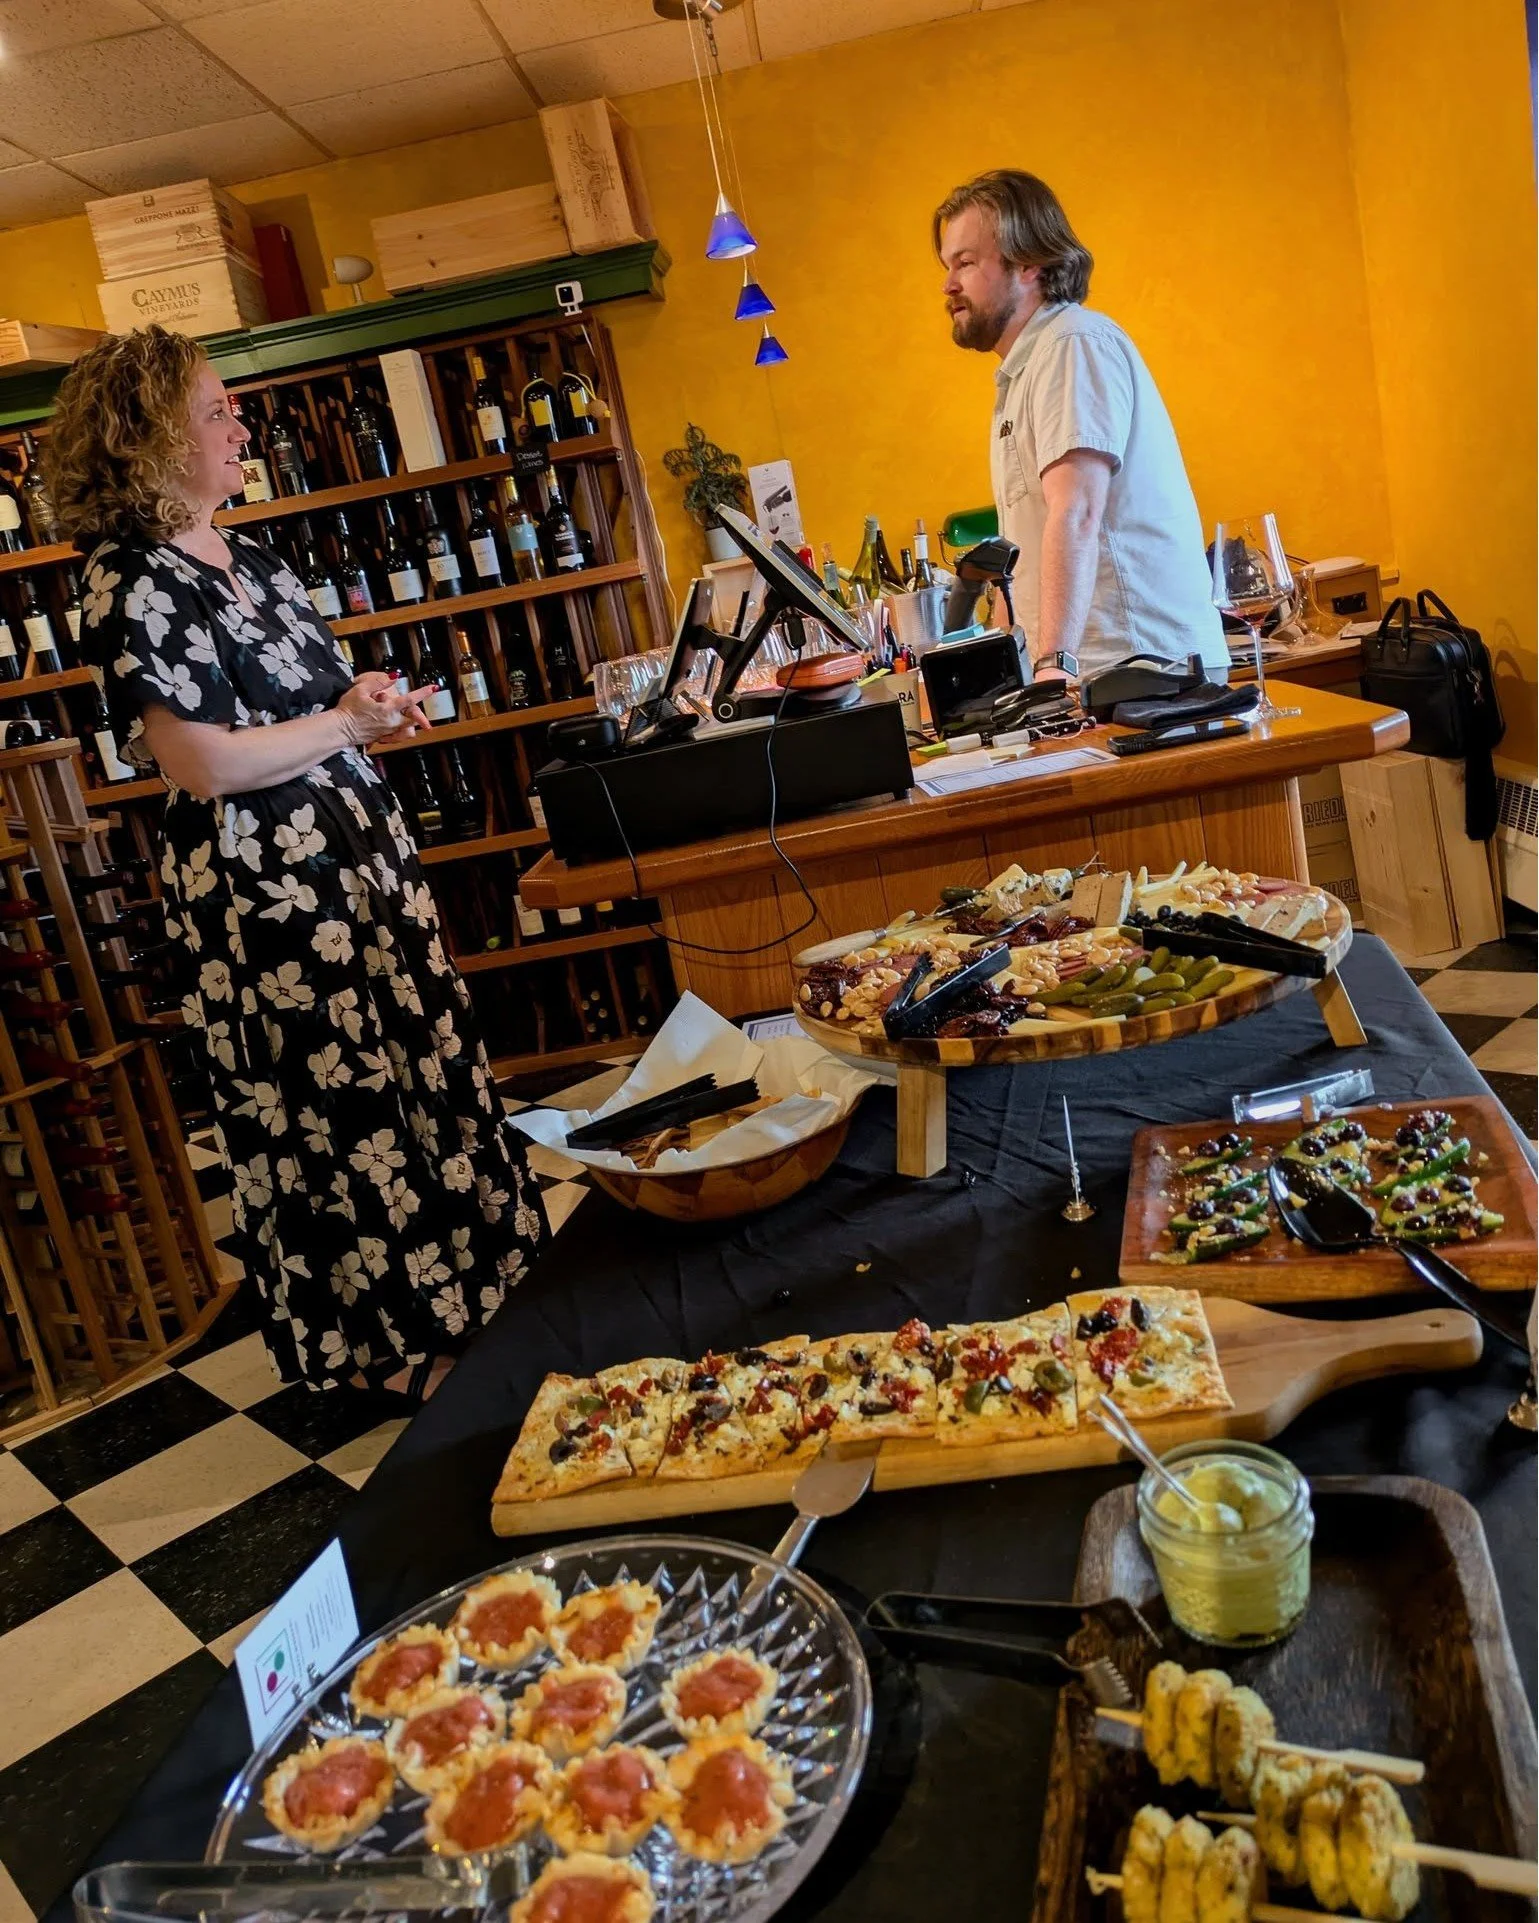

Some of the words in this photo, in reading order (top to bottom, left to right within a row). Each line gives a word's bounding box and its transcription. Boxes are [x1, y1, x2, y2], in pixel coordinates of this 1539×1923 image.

[134, 210, 173, 225] GREPPONE
[131, 282, 201, 308] CAYMUS
[138, 297, 200, 316] VINEYARDS
[1302, 796, 1346, 824] RIED
